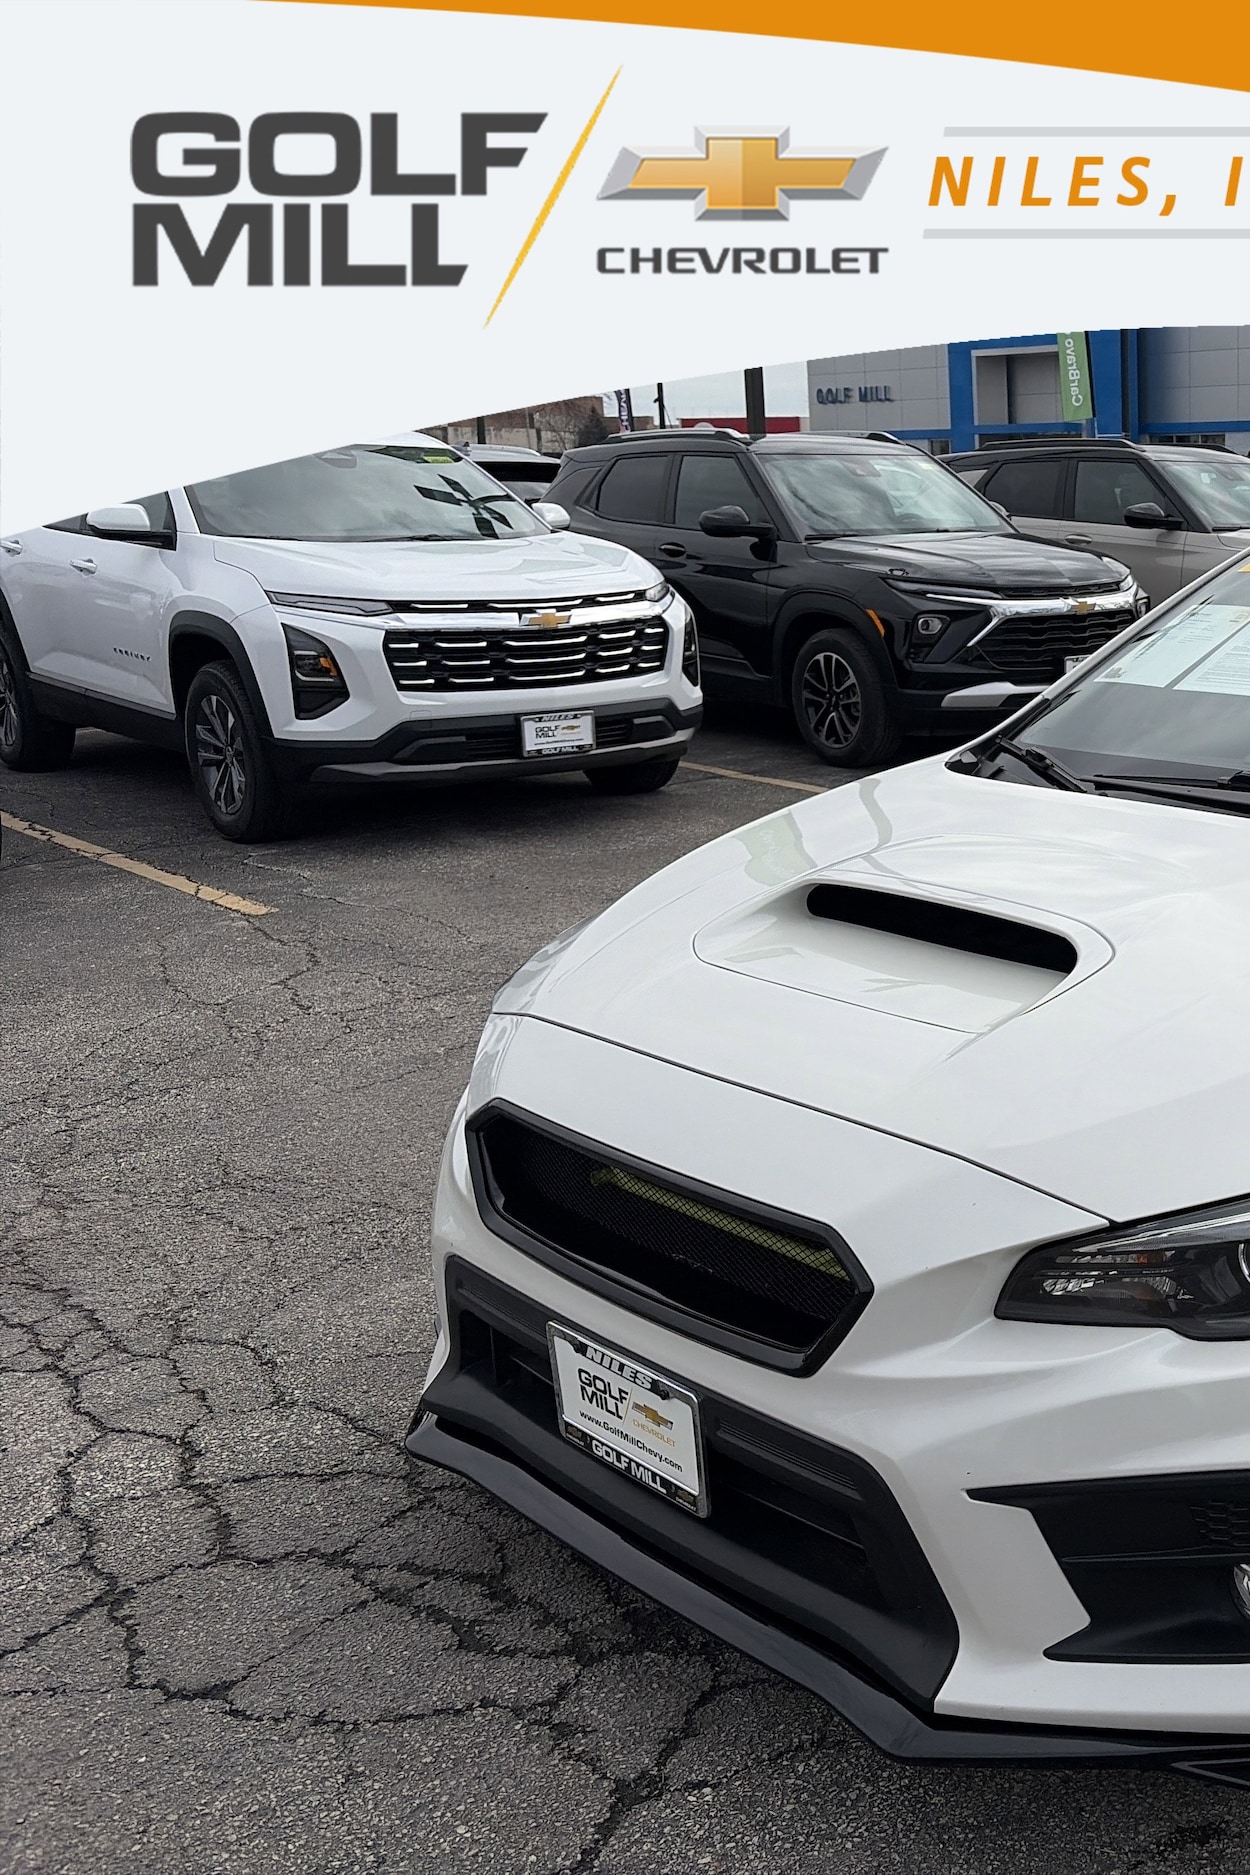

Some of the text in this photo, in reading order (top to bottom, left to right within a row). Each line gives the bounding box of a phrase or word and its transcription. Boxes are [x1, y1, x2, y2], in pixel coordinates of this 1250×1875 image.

[816, 385, 895, 404] GOLF MILL
[535, 724, 560, 733] GOLF
[578, 1368, 629, 1404] GOLF
[586, 1346, 652, 1390] NILES
[580, 1384, 623, 1420] MILL
[579, 1410, 683, 1473] www.GolfMillChevy.com
[632, 1418, 676, 1447] CHEVROLET
[592, 1440, 667, 1495] GOLF MILL
